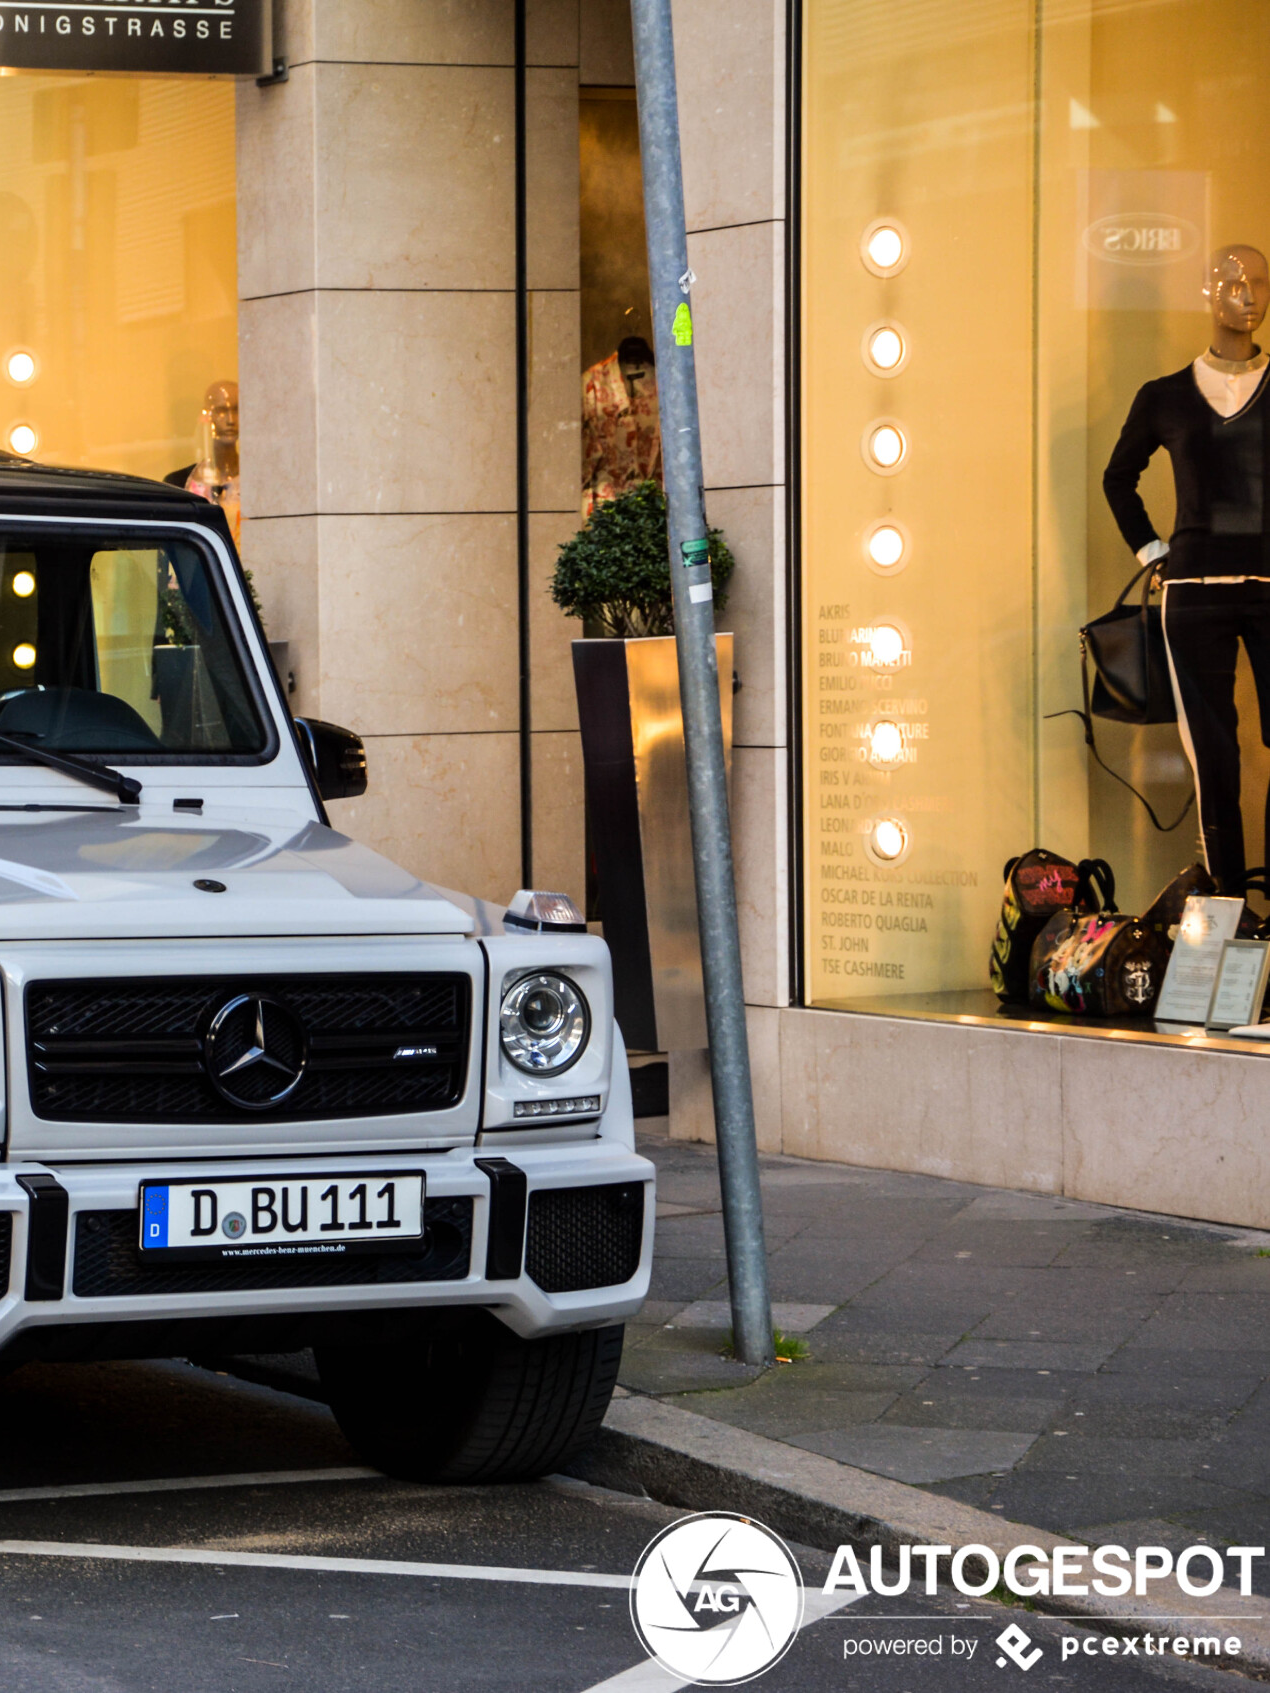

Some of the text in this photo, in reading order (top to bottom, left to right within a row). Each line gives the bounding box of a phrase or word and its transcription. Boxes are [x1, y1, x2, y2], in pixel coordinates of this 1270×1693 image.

[819, 604, 850, 620] AKRIS
[819, 675, 856, 691] EMILIO
[820, 770, 840, 786] IRIS
[820, 794, 850, 810] LANA
[821, 841, 853, 857] MALO
[821, 865, 870, 883] MICHAEL
[907, 869, 978, 888] COLLECTION
[821, 888, 934, 909] OSCAR DE LA RENTA
[821, 912, 928, 933] ROBERTO QUAGLIA
[821, 935, 869, 953] ST. JOHN
[821, 958, 905, 980] TSE CASHMERE
[190, 1182, 401, 1237] D BU 111
[150, 1223, 160, 1238] D
[222, 1244, 346, 1257] www.mercedes-benz-muenchen.de
